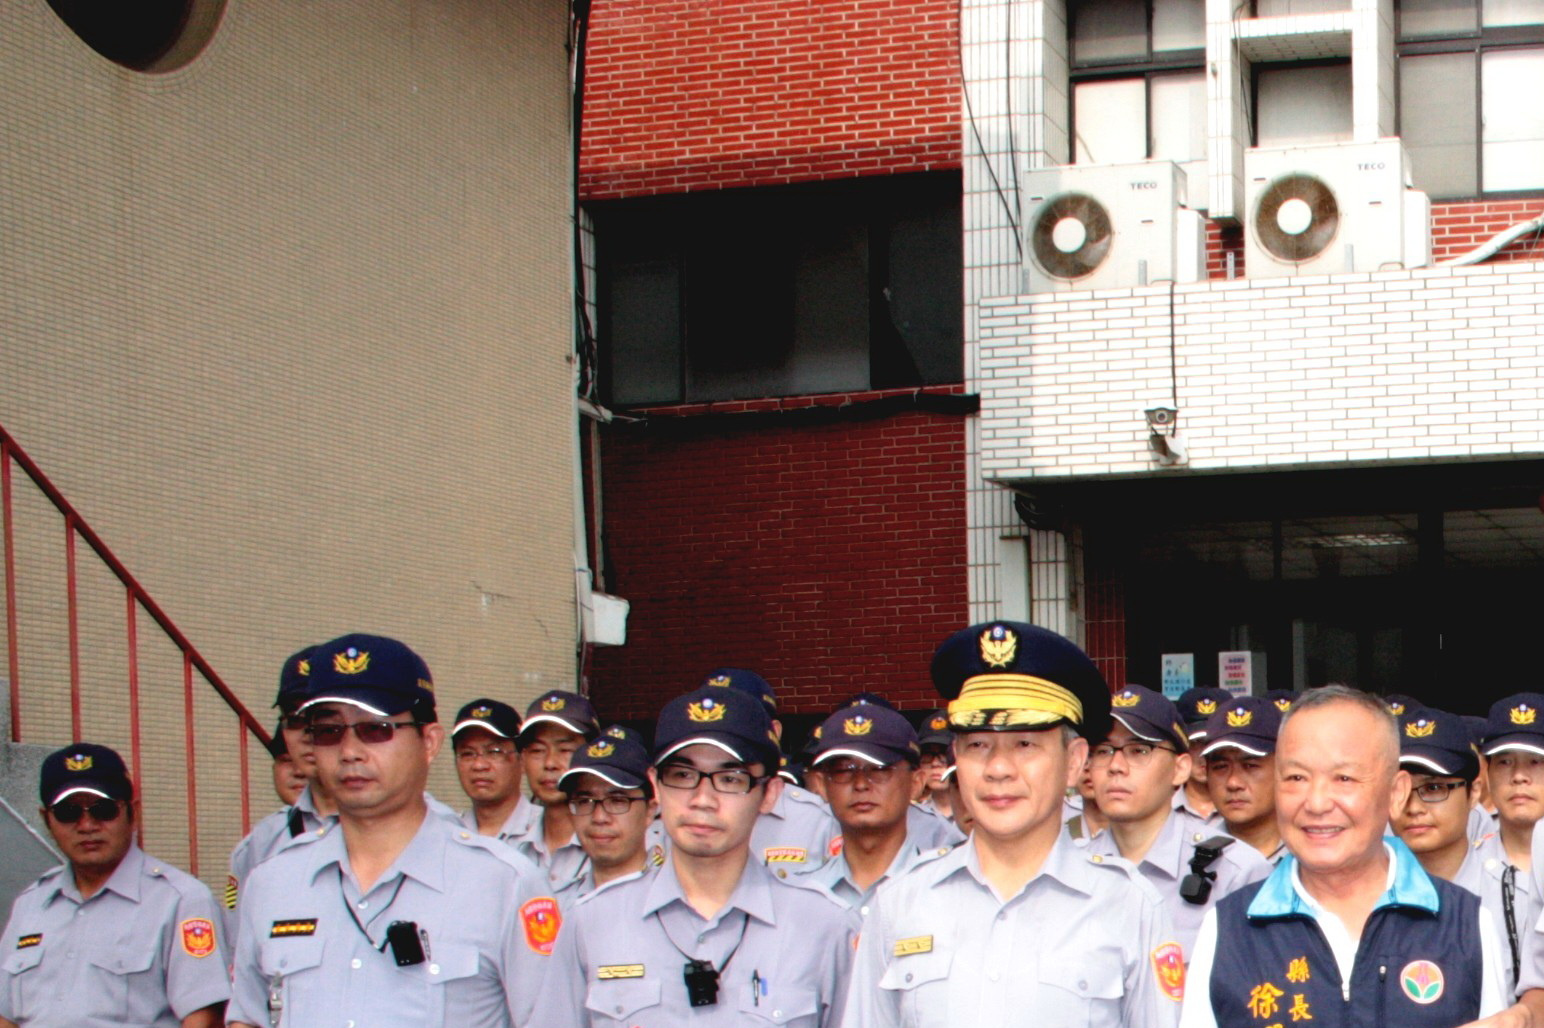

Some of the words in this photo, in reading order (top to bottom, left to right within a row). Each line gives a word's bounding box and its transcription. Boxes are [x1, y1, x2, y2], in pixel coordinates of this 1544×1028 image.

[1357, 162, 1385, 171] TECO
[1130, 182, 1158, 191] TECO
[1286, 955, 1313, 1022] 縣長
